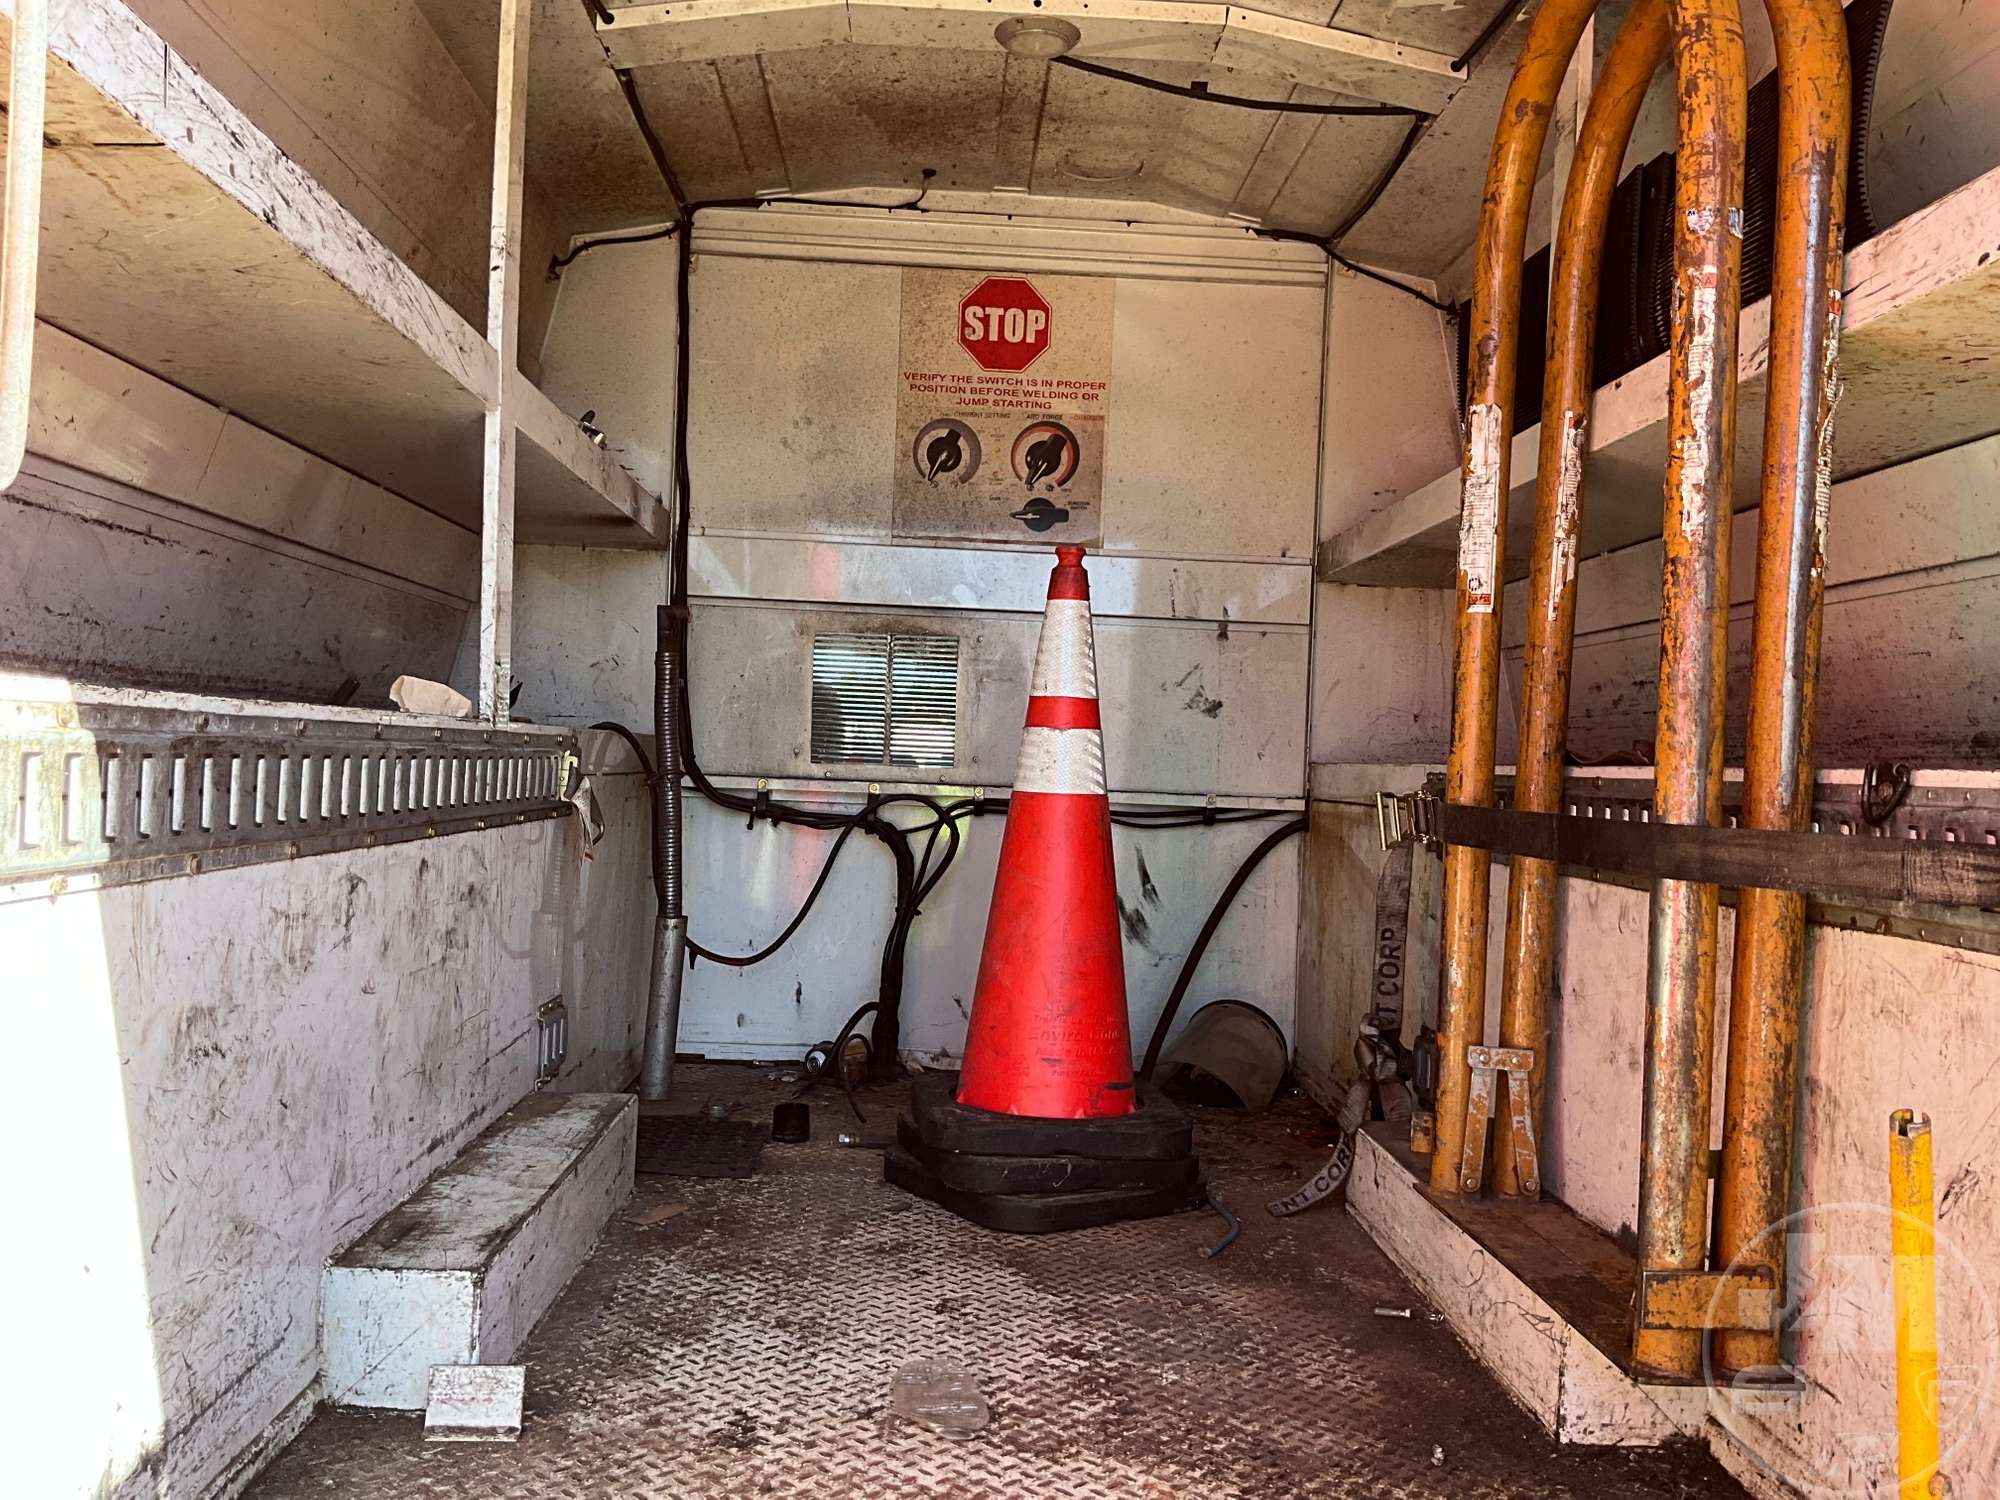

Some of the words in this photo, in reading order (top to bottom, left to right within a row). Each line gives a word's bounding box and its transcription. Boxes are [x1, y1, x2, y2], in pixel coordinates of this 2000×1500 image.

[964, 305, 1046, 343] STOP
[903, 372, 947, 382] VERIFY
[950, 374, 973, 384] THE
[977, 376, 1024, 387] SWITCH
[1026, 378, 1038, 387] IS
[1041, 379, 1053, 388] IN
[1056, 380, 1107, 390] PROPER
[910, 384, 967, 394] POSITION
[970, 387, 1019, 397] BEFORE
[1022, 389, 1078, 400] WELDING
[1081, 392, 1100, 401] OR
[956, 397, 989, 406] JUMP
[992, 399, 1052, 410] STARTING
[1376, 927, 1401, 997] CORP
[1315, 1140, 1351, 1192] COR
